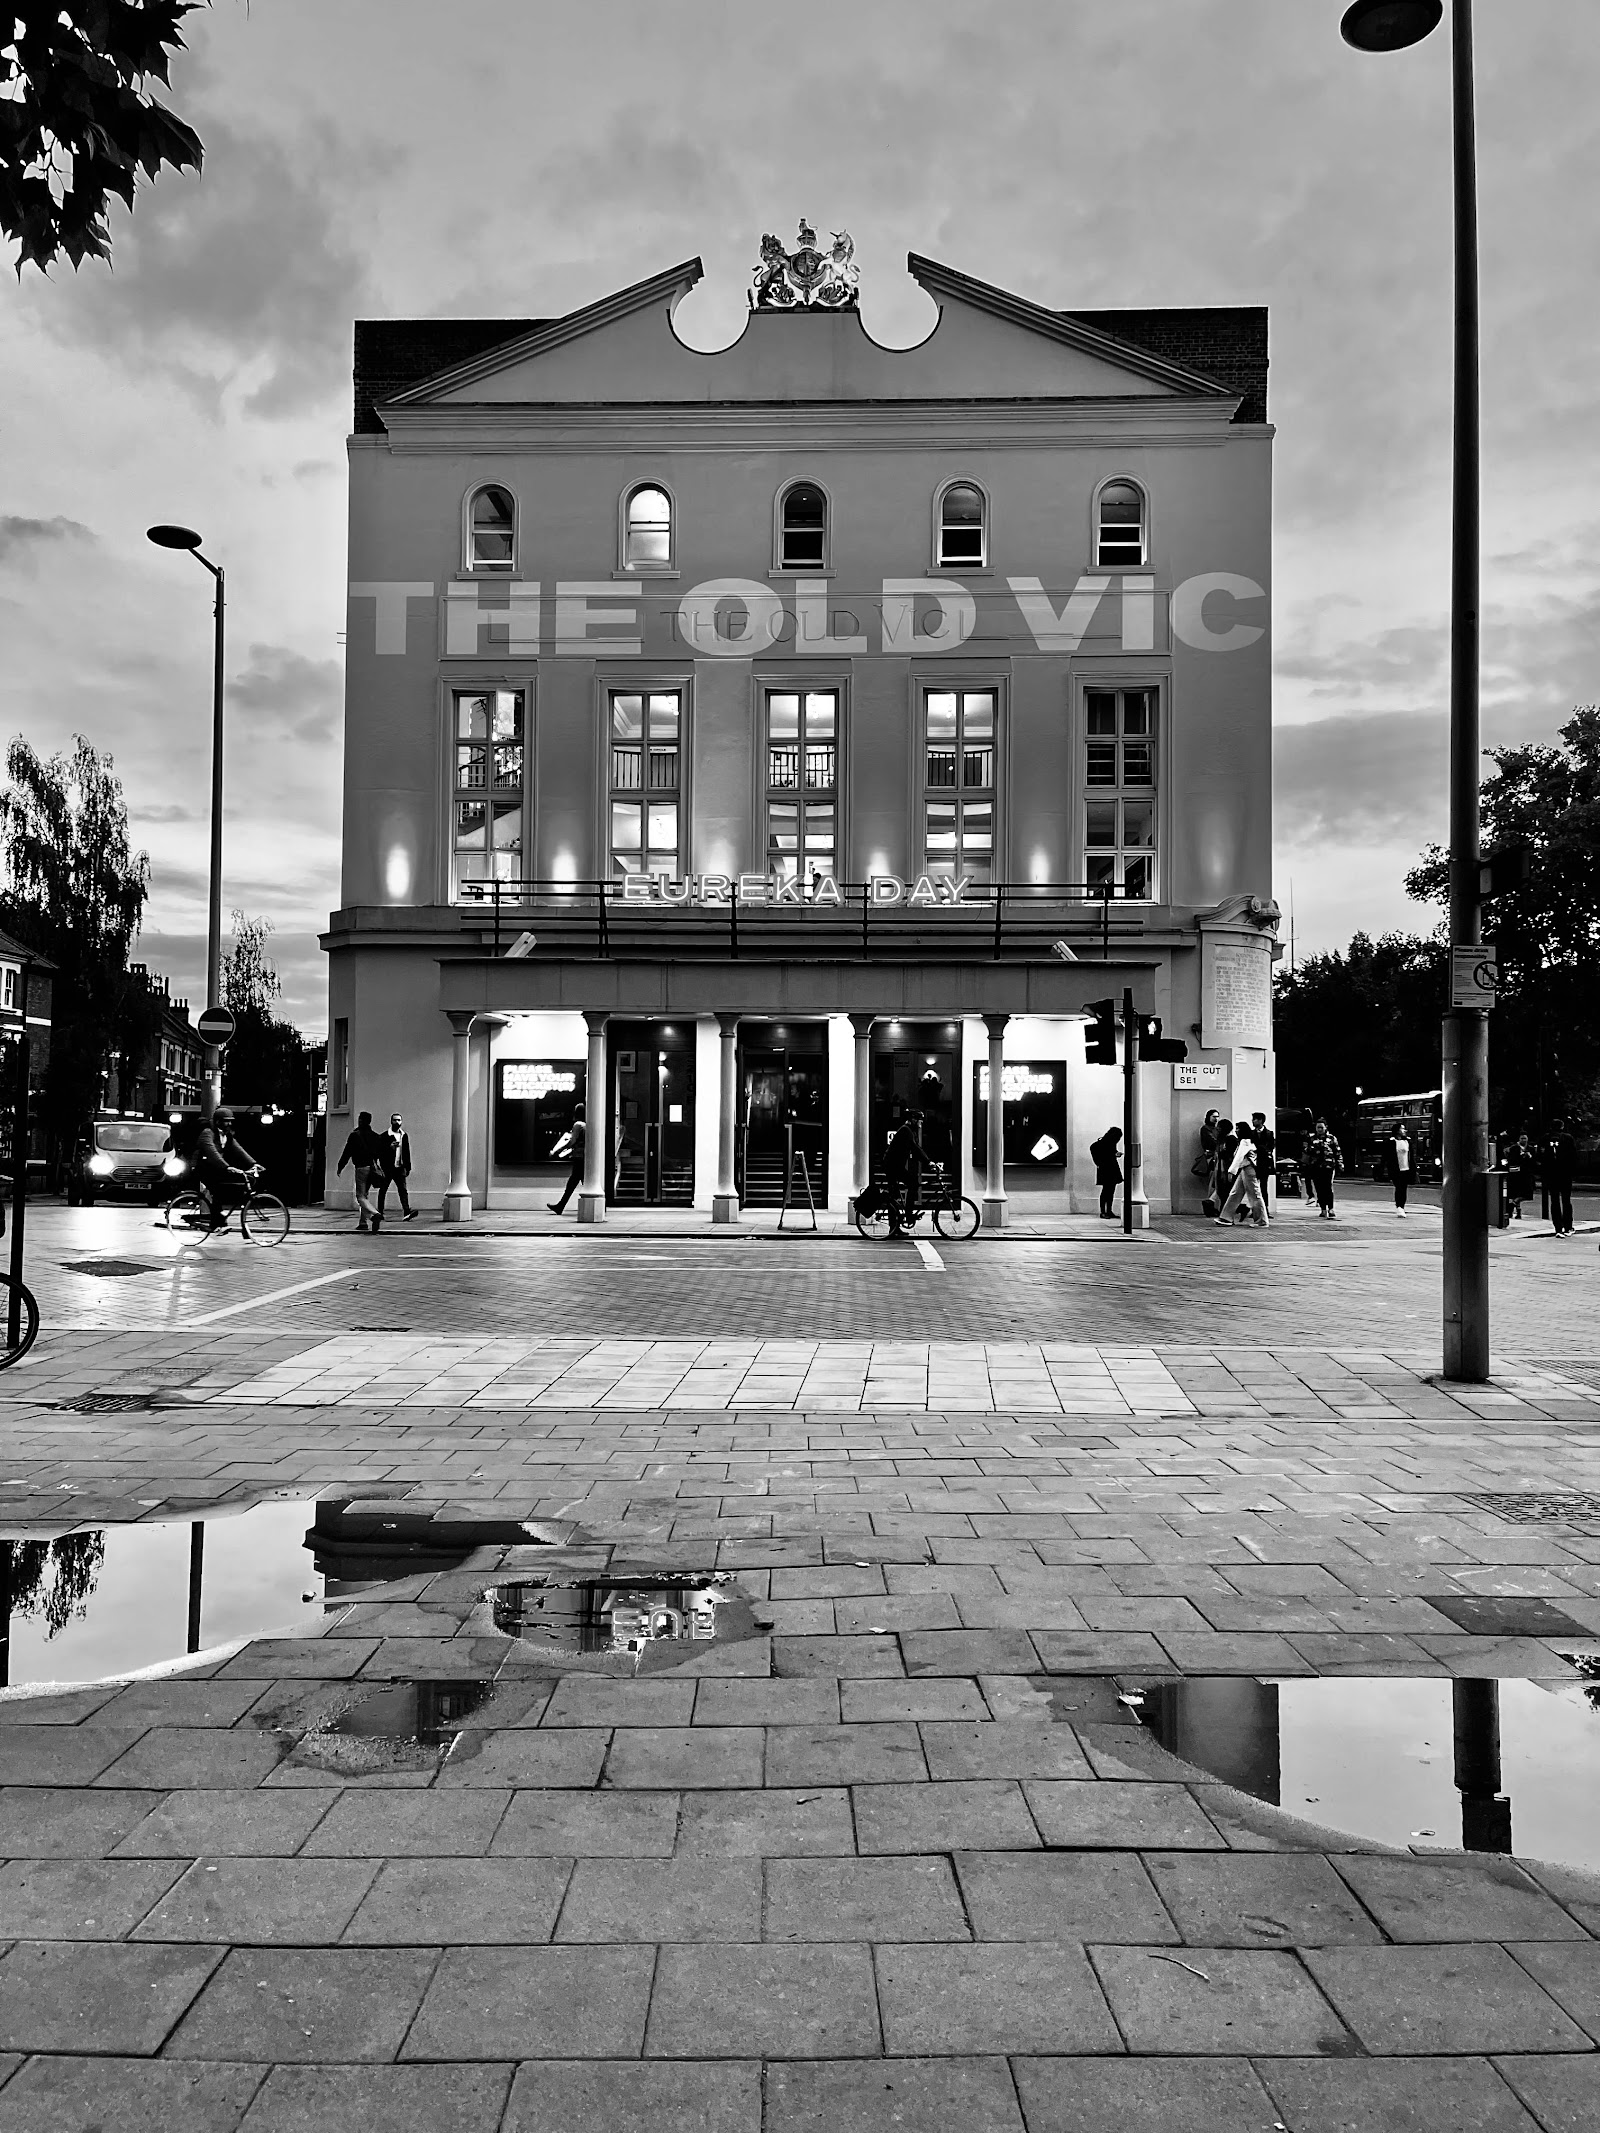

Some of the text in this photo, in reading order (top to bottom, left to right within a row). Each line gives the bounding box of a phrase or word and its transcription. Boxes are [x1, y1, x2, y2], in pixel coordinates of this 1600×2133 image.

[349, 571, 1267, 656] THE OLD VIC
[659, 609, 754, 643] THE
[766, 608, 860, 643] OLD
[622, 872, 974, 903] EUREKA DAY
[503, 1065, 553, 1074] PLEASE
[1179, 1066, 1221, 1075] THE CUT
[503, 1073, 576, 1082] HAVE YOUR
[1179, 1076, 1197, 1084] SE1
